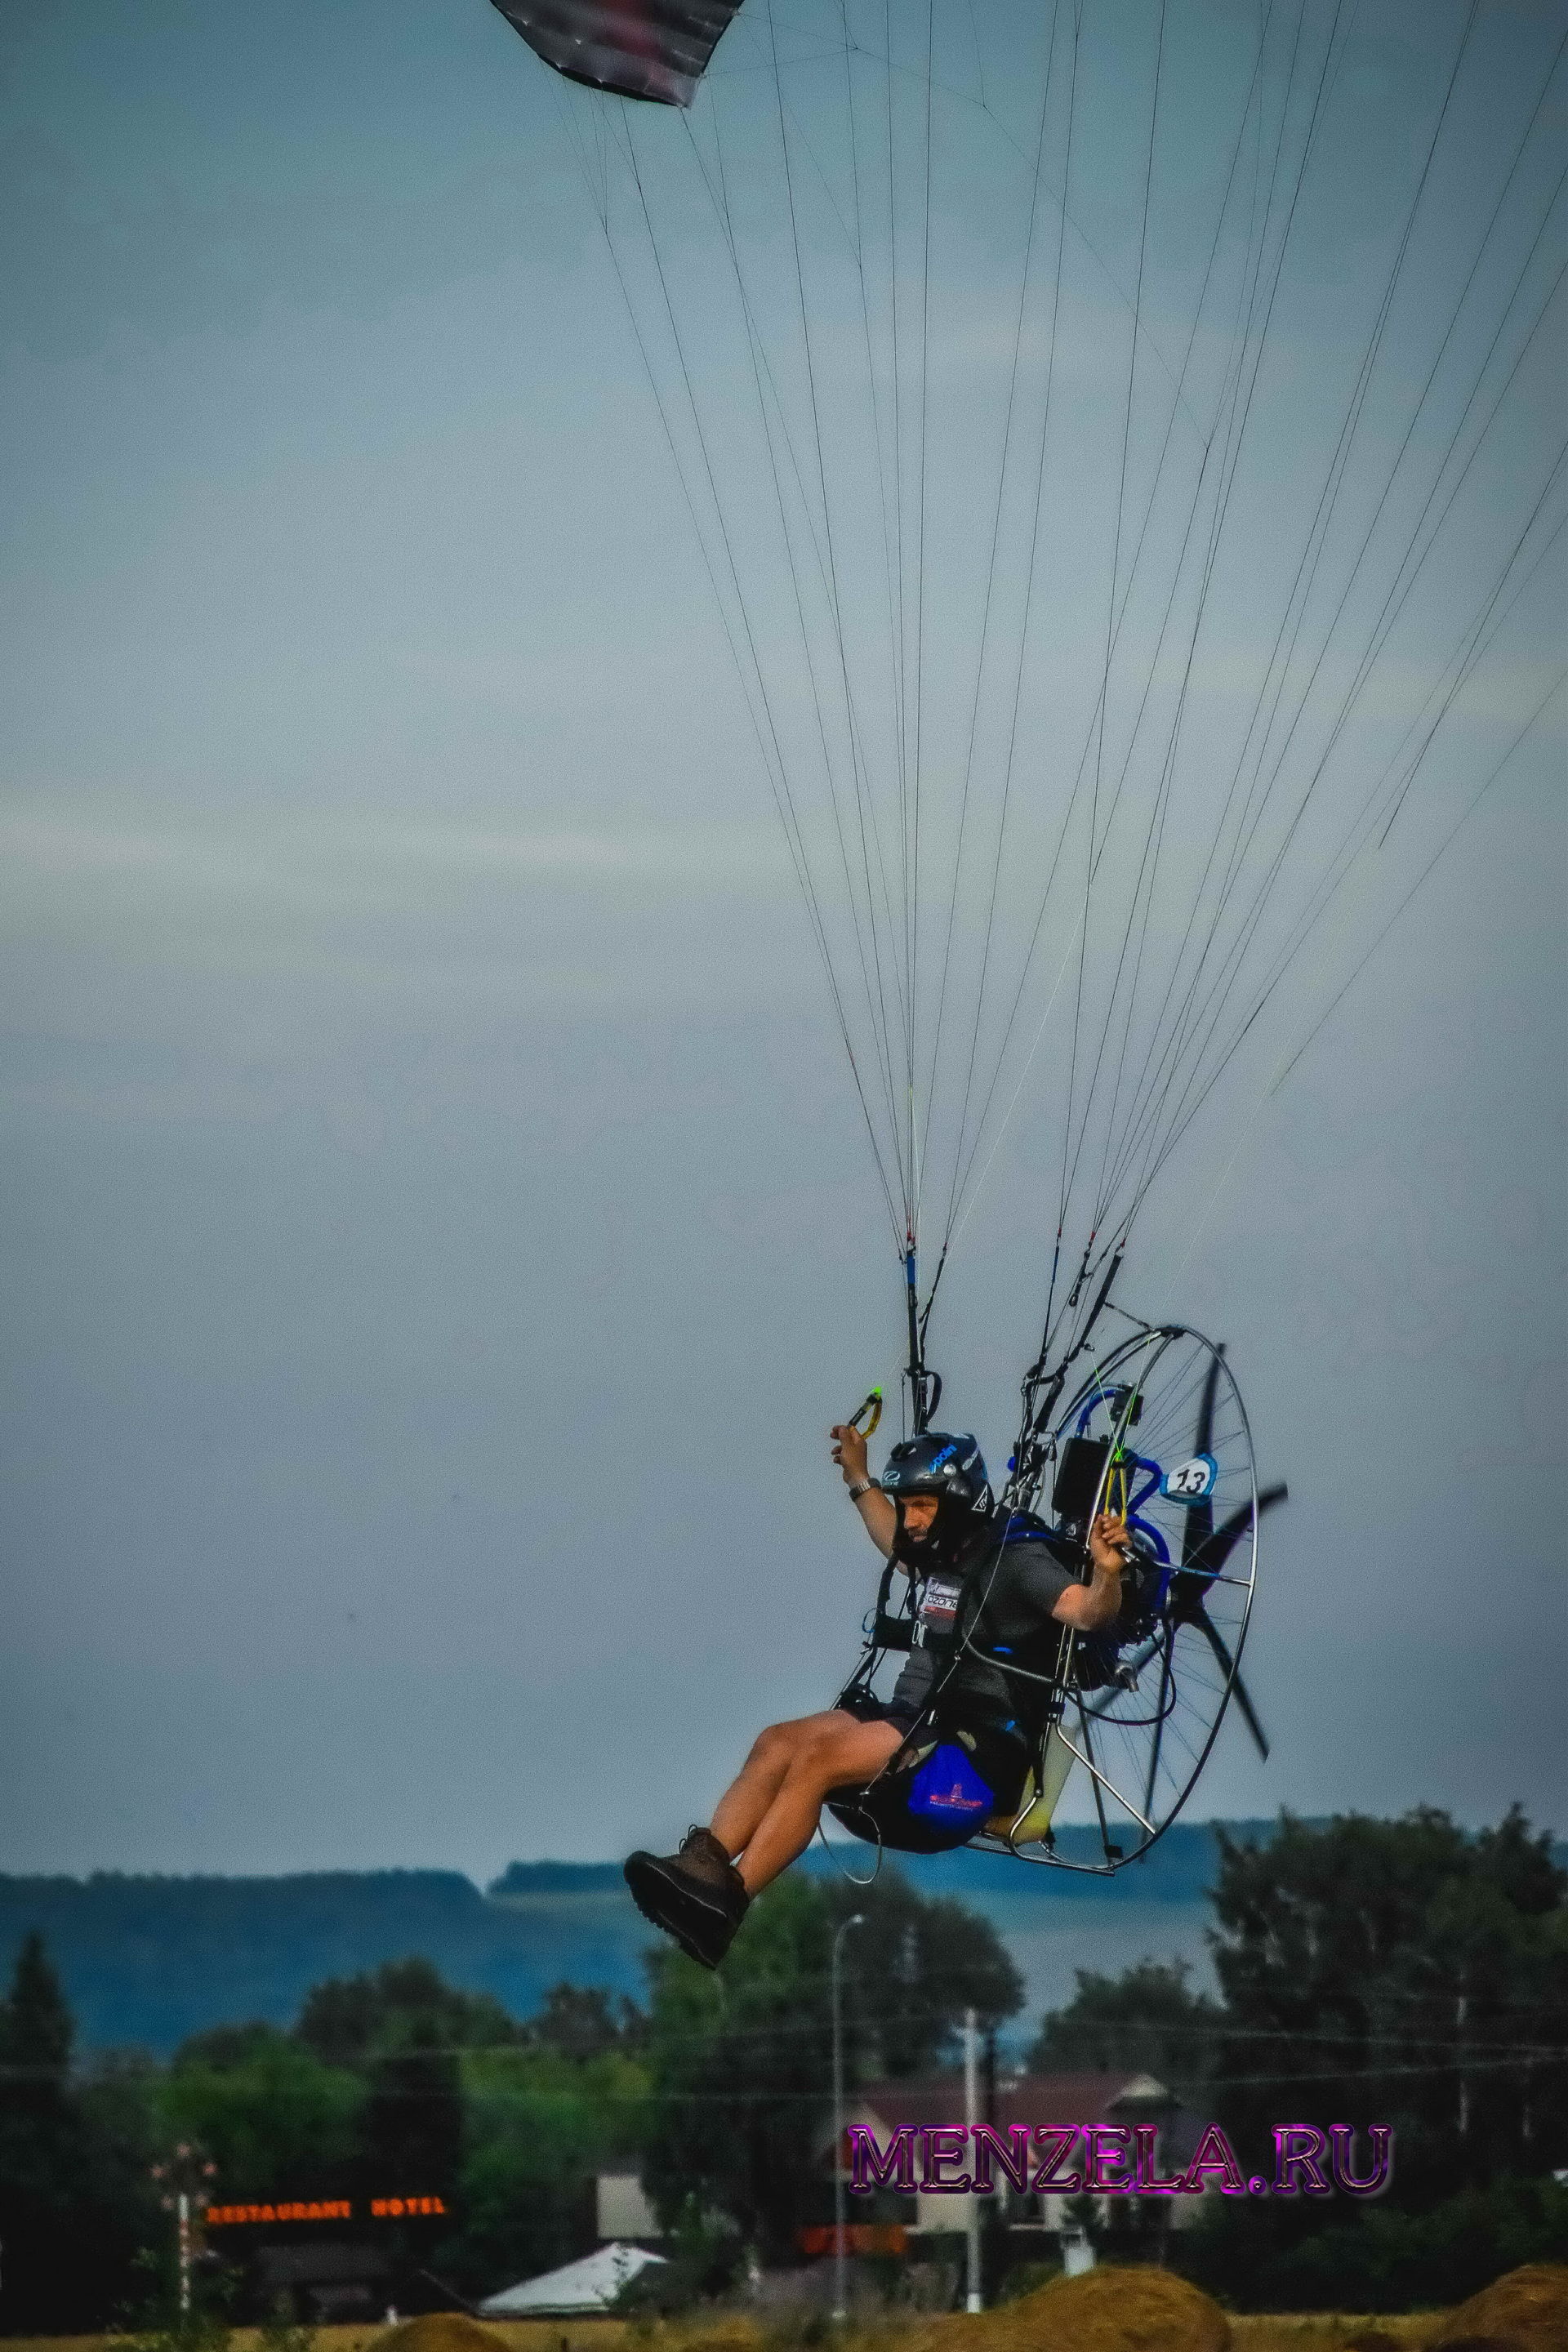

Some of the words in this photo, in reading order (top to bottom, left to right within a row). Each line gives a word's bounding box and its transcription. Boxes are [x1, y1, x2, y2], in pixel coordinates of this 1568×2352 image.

[1178, 1468, 1205, 1494] 13
[207, 2200, 351, 2223] RESTAURANT
[371, 2197, 445, 2216] HOTEL
